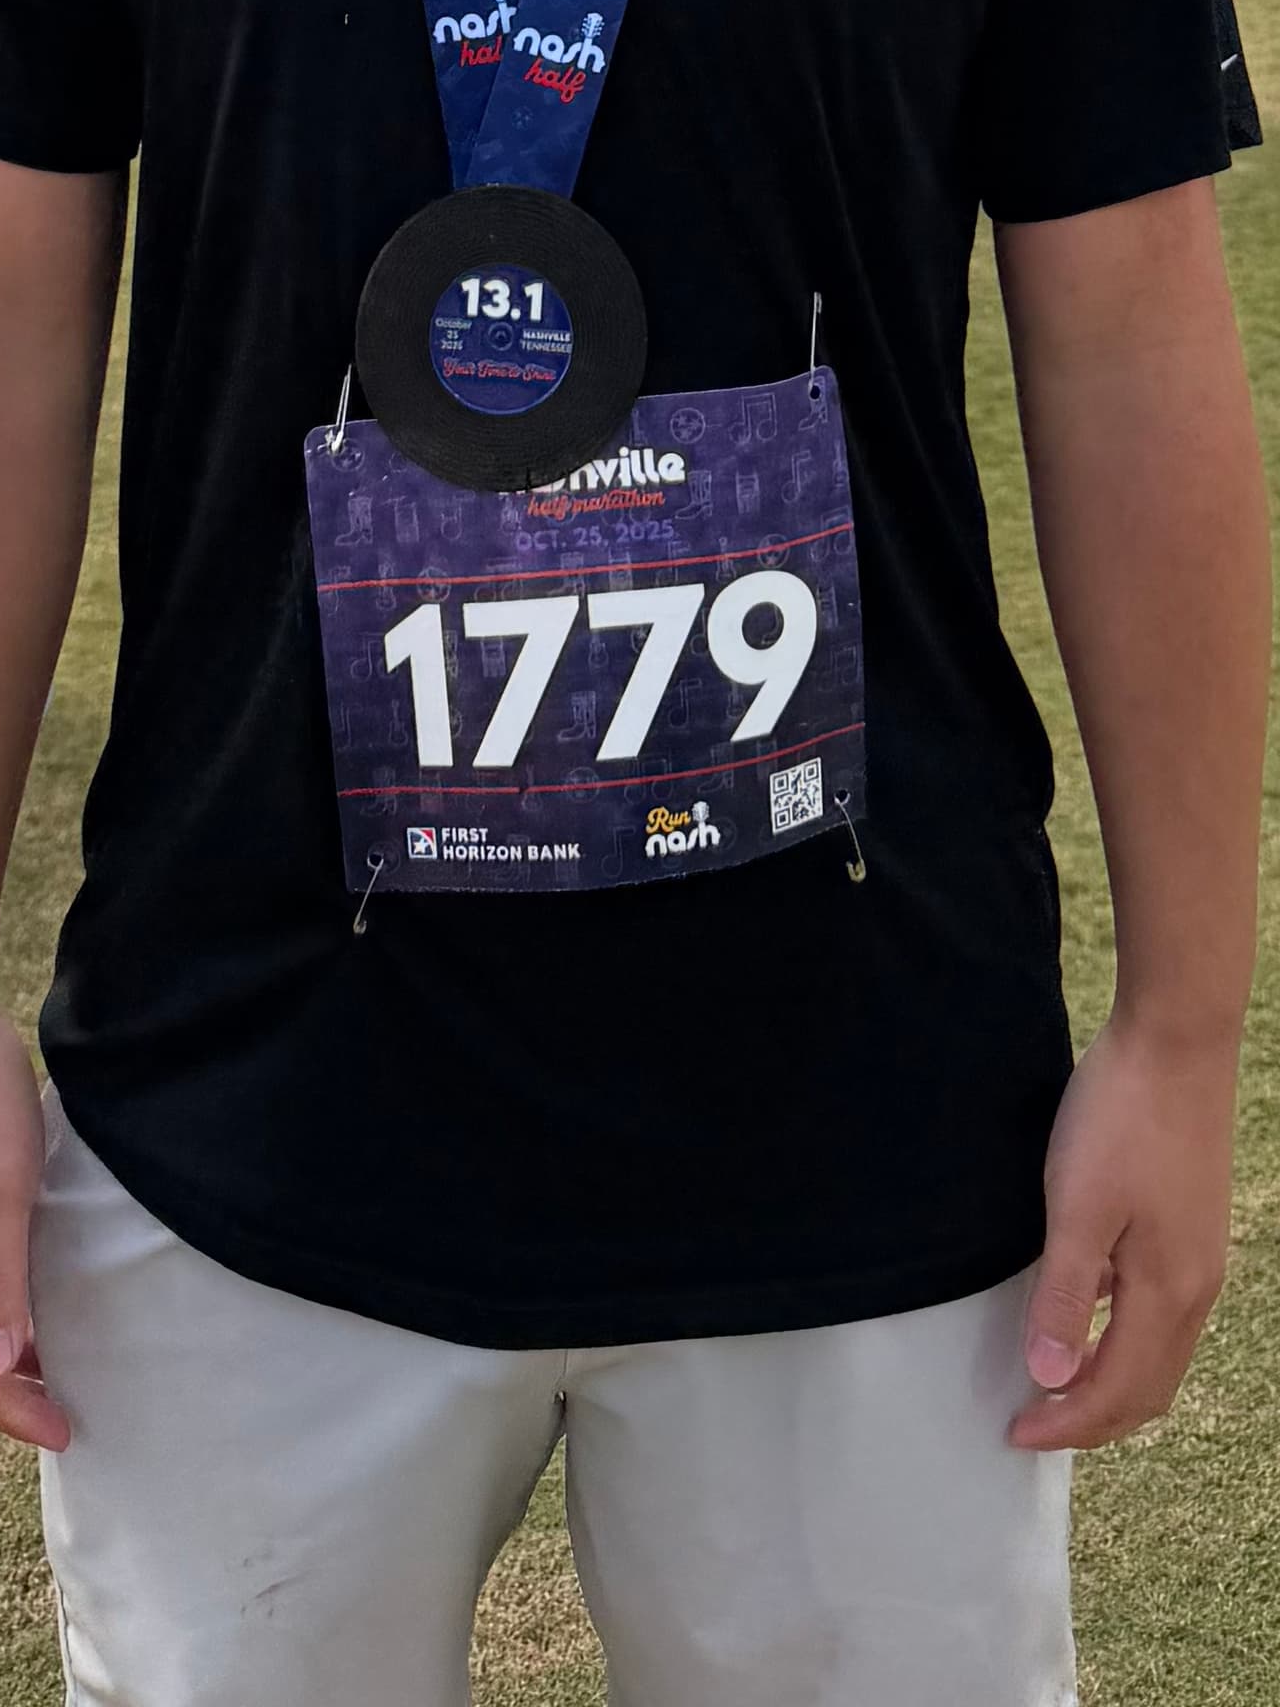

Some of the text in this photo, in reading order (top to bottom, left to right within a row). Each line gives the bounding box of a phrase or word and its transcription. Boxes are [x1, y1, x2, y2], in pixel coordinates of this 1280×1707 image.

[459, 35, 503, 67] hal
[513, 12, 606, 74] nash
[523, 58, 587, 104] half
[461, 278, 544, 321] 13.1
[435, 317, 472, 330] October
[522, 330, 571, 343] NASHVILLE
[520, 340, 572, 354] TENNESSEE
[527, 488, 667, 521] half marathon
[516, 518, 675, 551] OCT. 25, 2025
[383, 569, 818, 768] 1779
[441, 827, 489, 843] FIRST
[645, 806, 692, 834] Run
[645, 800, 721, 857] nash
[442, 842, 582, 861] HORIZON BANK
